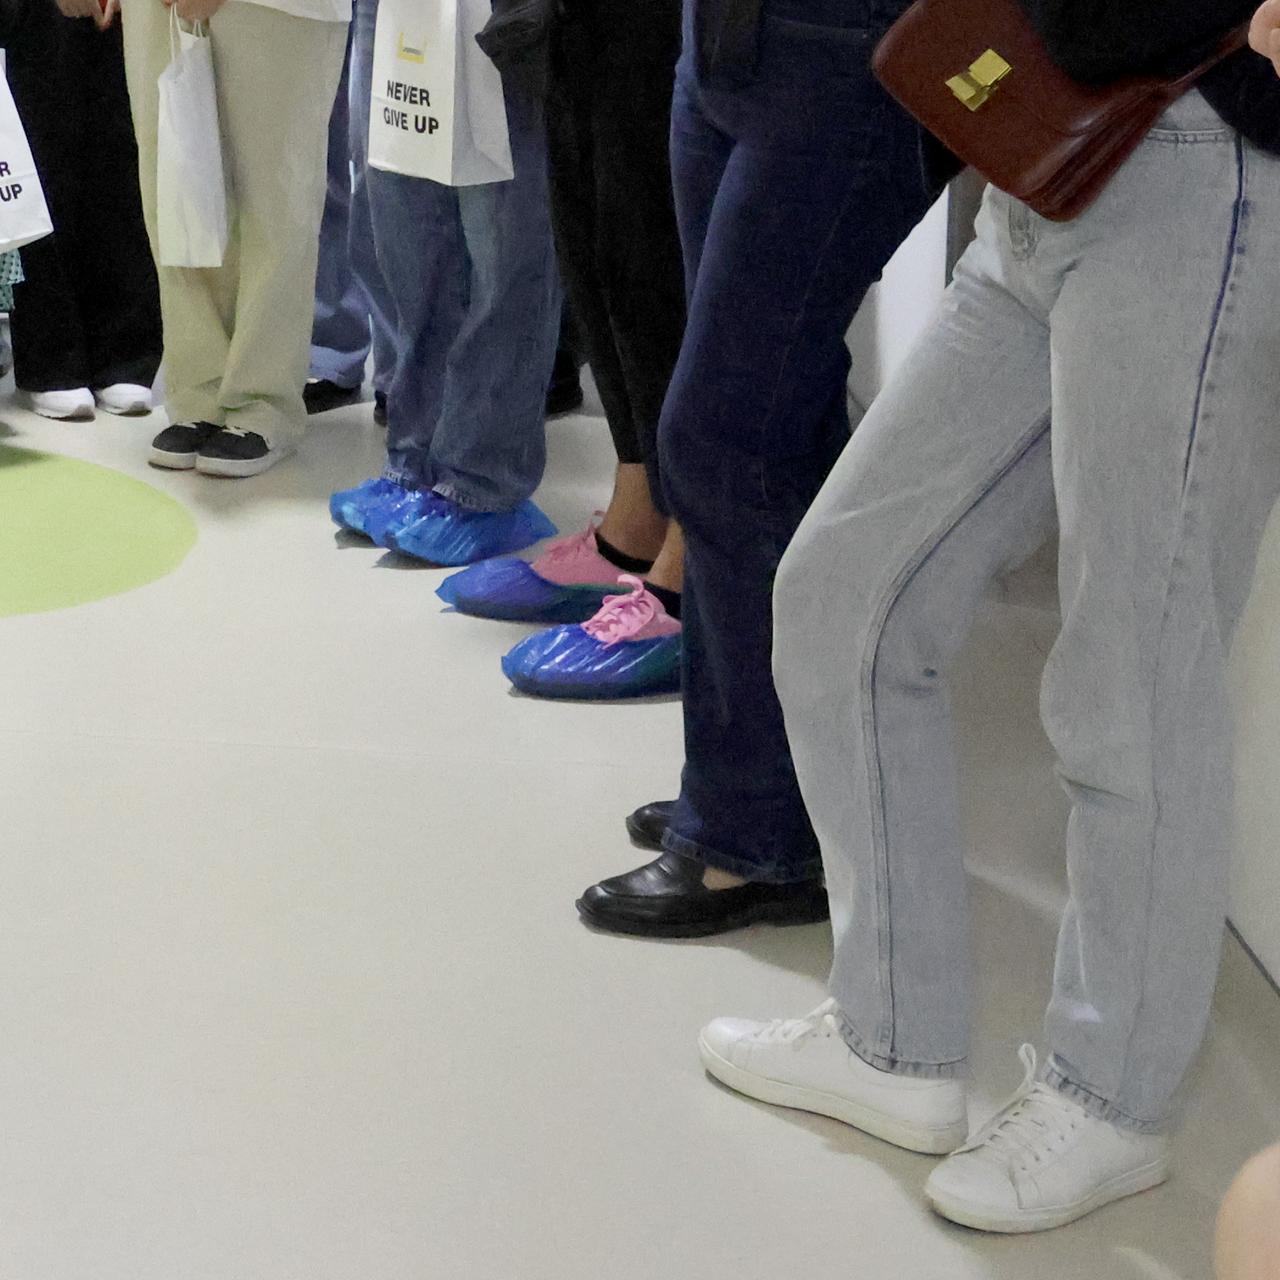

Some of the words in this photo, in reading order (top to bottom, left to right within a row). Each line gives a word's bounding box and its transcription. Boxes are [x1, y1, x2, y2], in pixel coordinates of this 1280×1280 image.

[386, 80, 431, 107] NEVER
[383, 107, 409, 131] GIVE
[414, 115, 439, 135] UP
